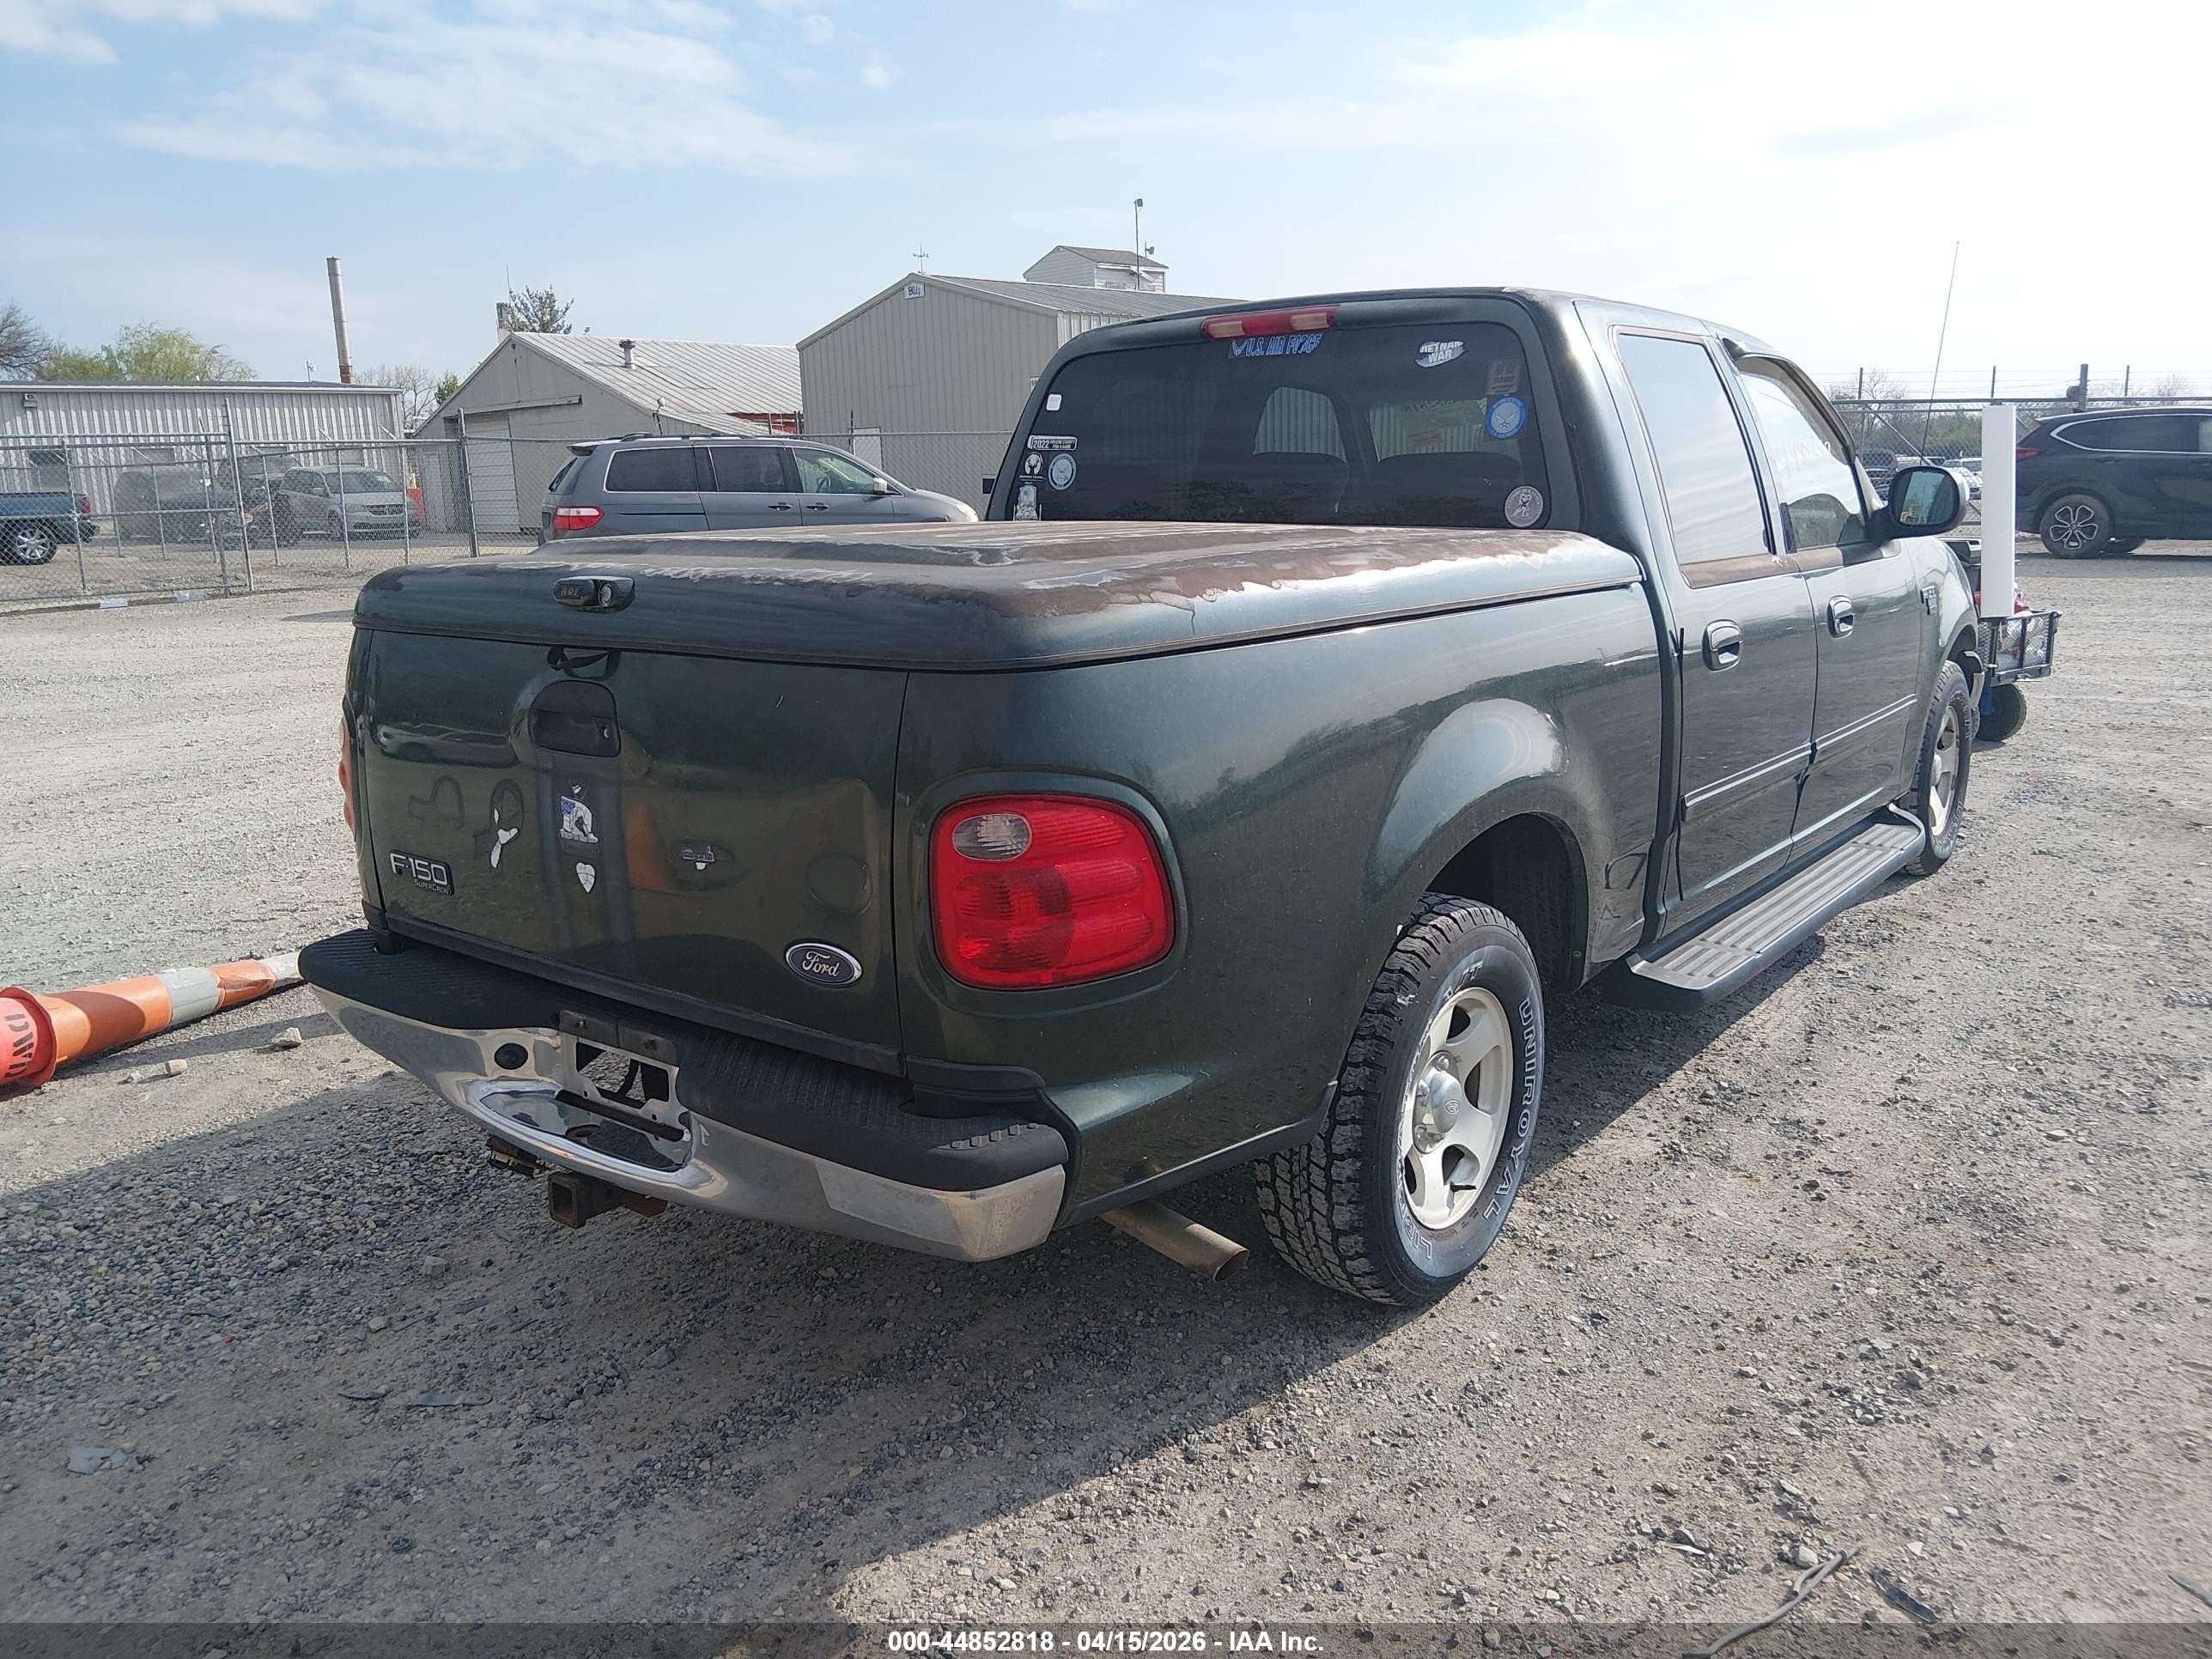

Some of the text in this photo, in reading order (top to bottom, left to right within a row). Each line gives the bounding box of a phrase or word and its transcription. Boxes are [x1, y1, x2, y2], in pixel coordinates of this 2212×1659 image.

[1266, 336, 1286, 356] AIR
[1429, 349, 1452, 362] WAR
[1033, 440, 1050, 449] 2022
[802, 951, 840, 976] Ford
[1483, 998, 1537, 1219] UNIROYAL
